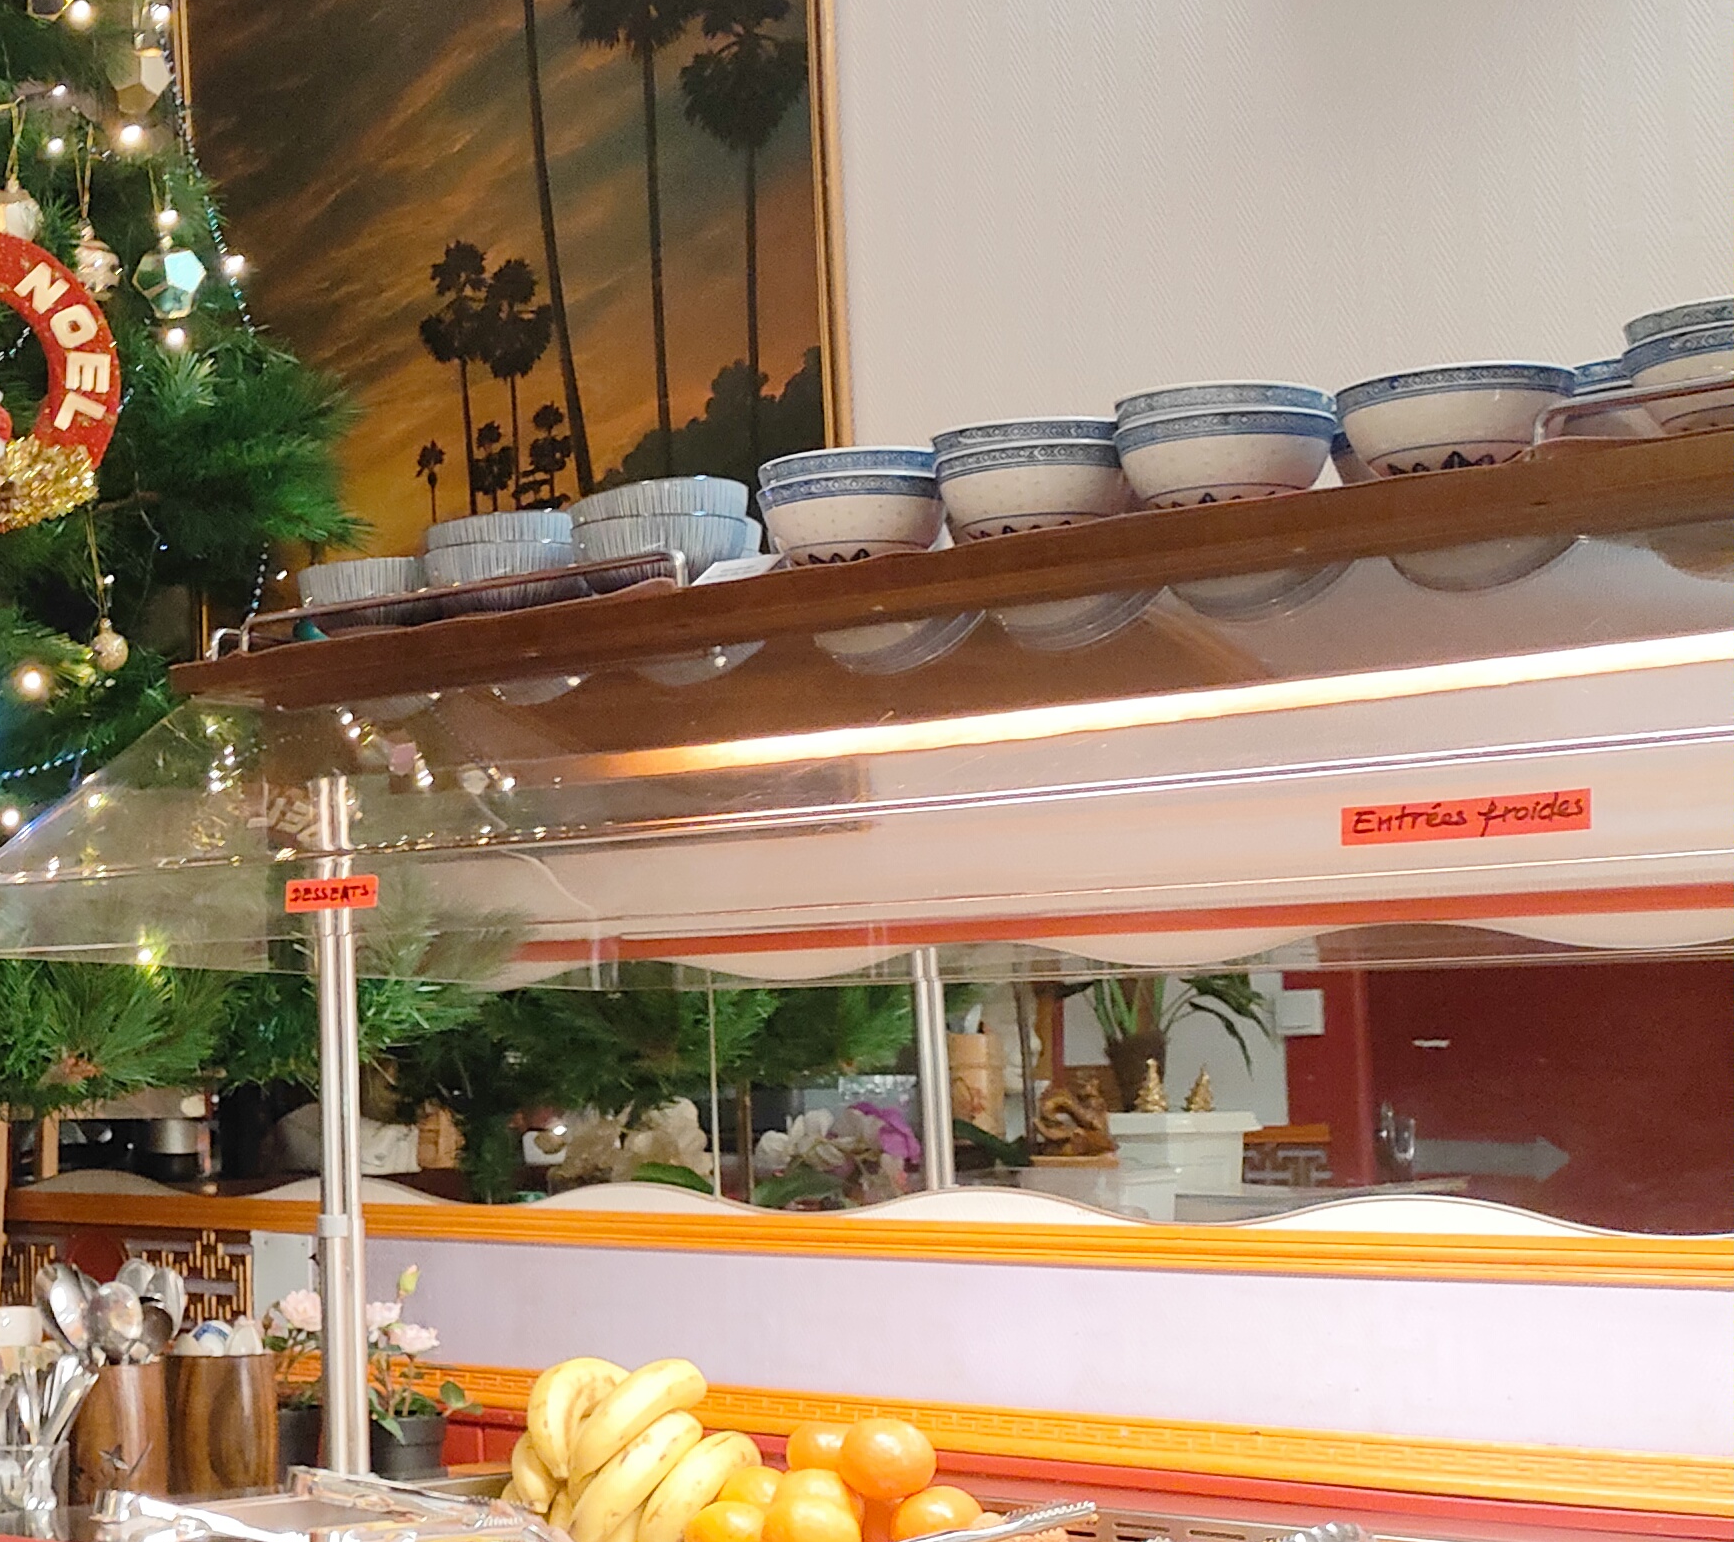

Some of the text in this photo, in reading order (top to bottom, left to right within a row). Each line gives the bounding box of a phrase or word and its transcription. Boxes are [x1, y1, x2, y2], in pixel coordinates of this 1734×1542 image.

[13, 260, 112, 431] NOEL
[1351, 791, 1584, 838] Entrées froides
